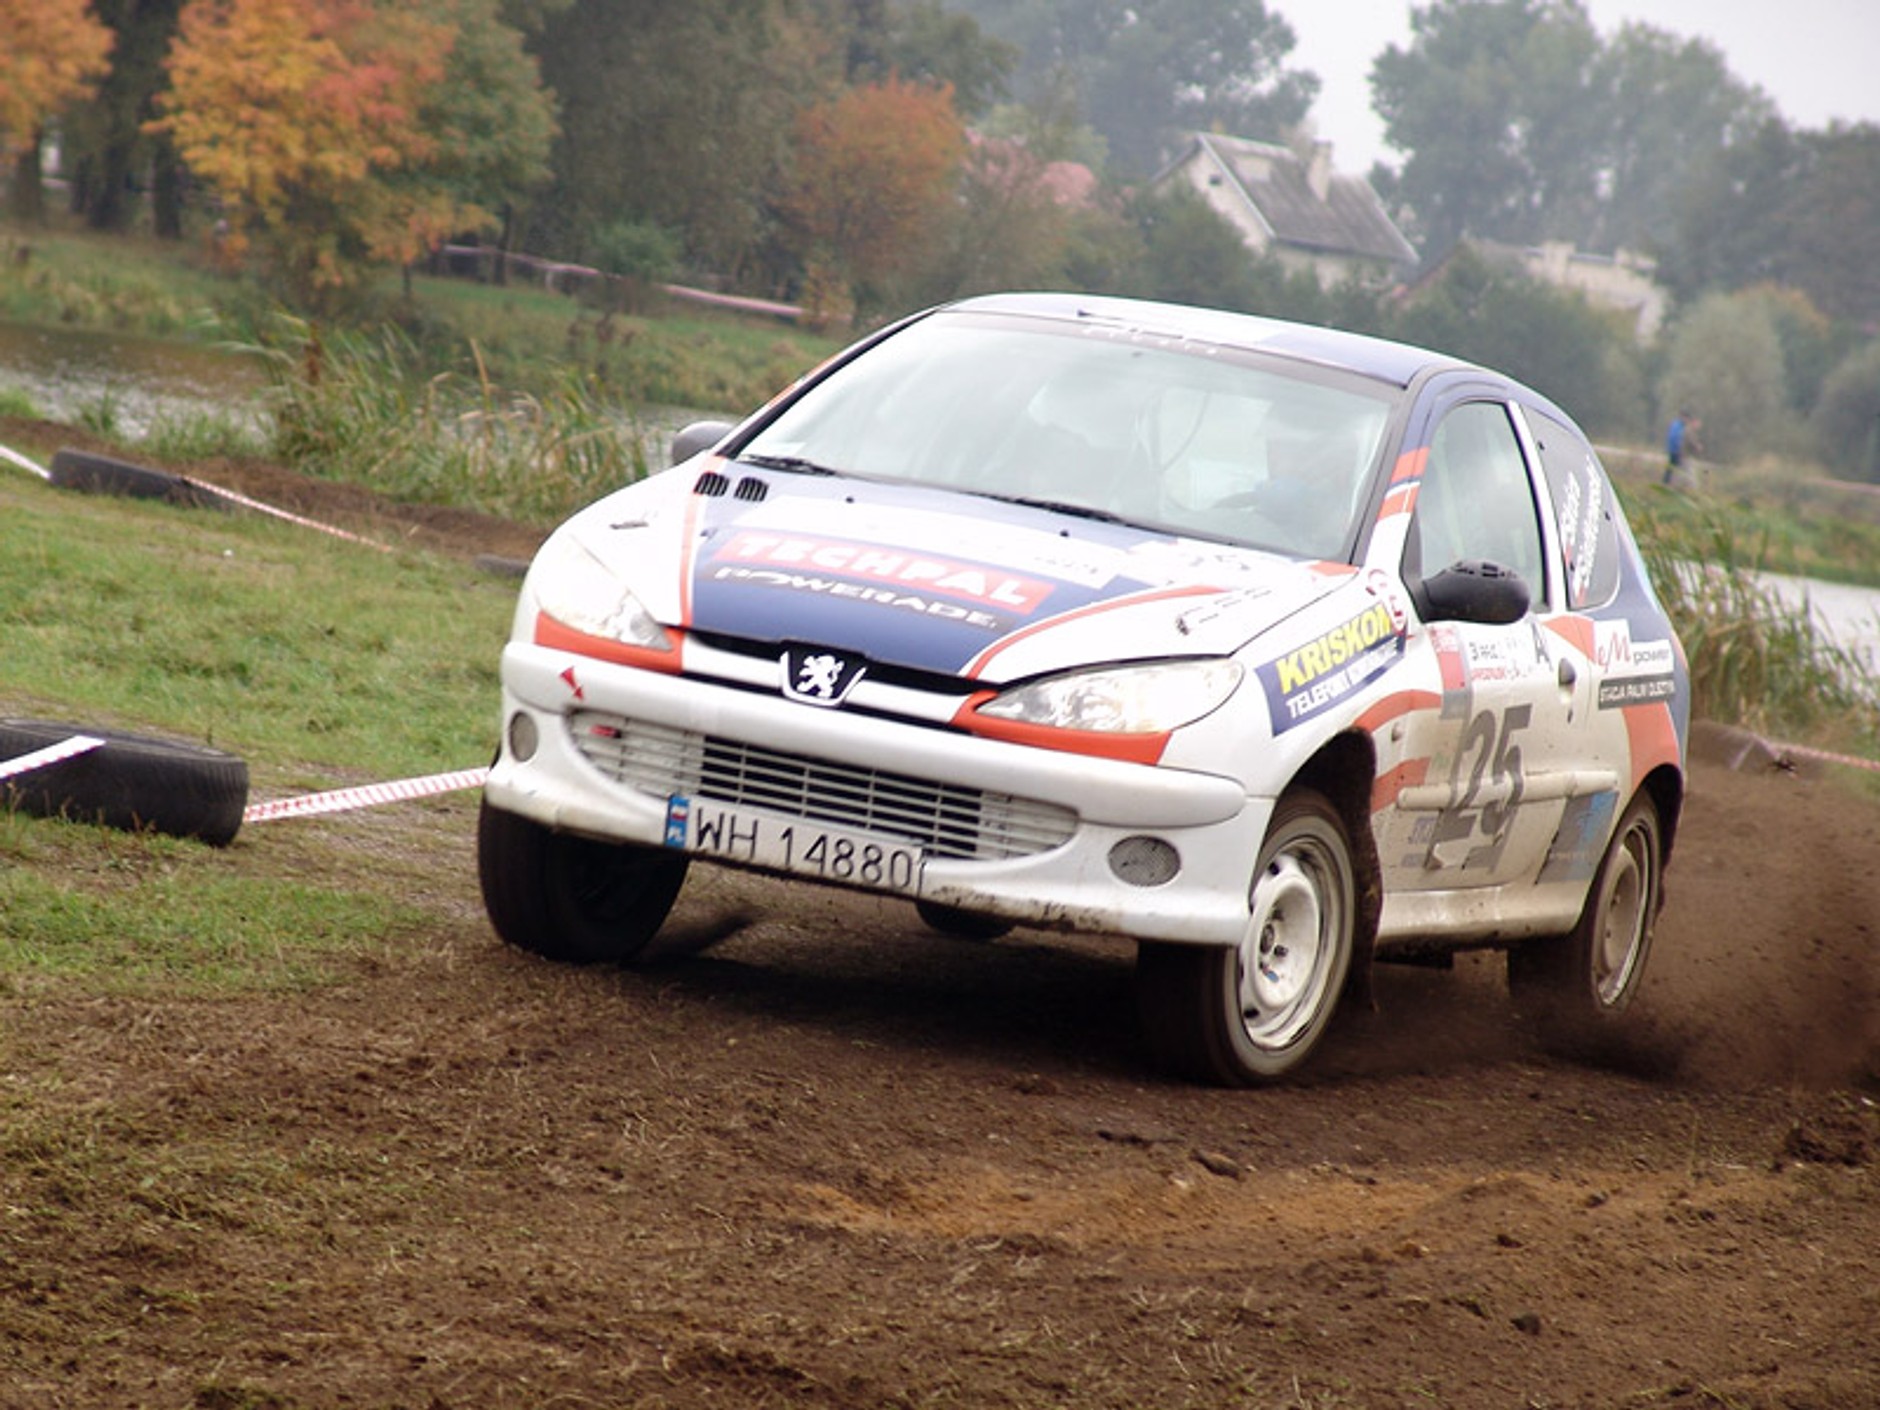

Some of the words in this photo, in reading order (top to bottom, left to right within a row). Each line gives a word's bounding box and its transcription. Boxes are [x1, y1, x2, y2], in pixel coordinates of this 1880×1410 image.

[713, 565, 996, 629] POWERADE
[735, 535, 1029, 606] TECHPAL
[1432, 703, 1533, 844] 25
[697, 806, 758, 861] WH
[780, 826, 912, 889] 14880
